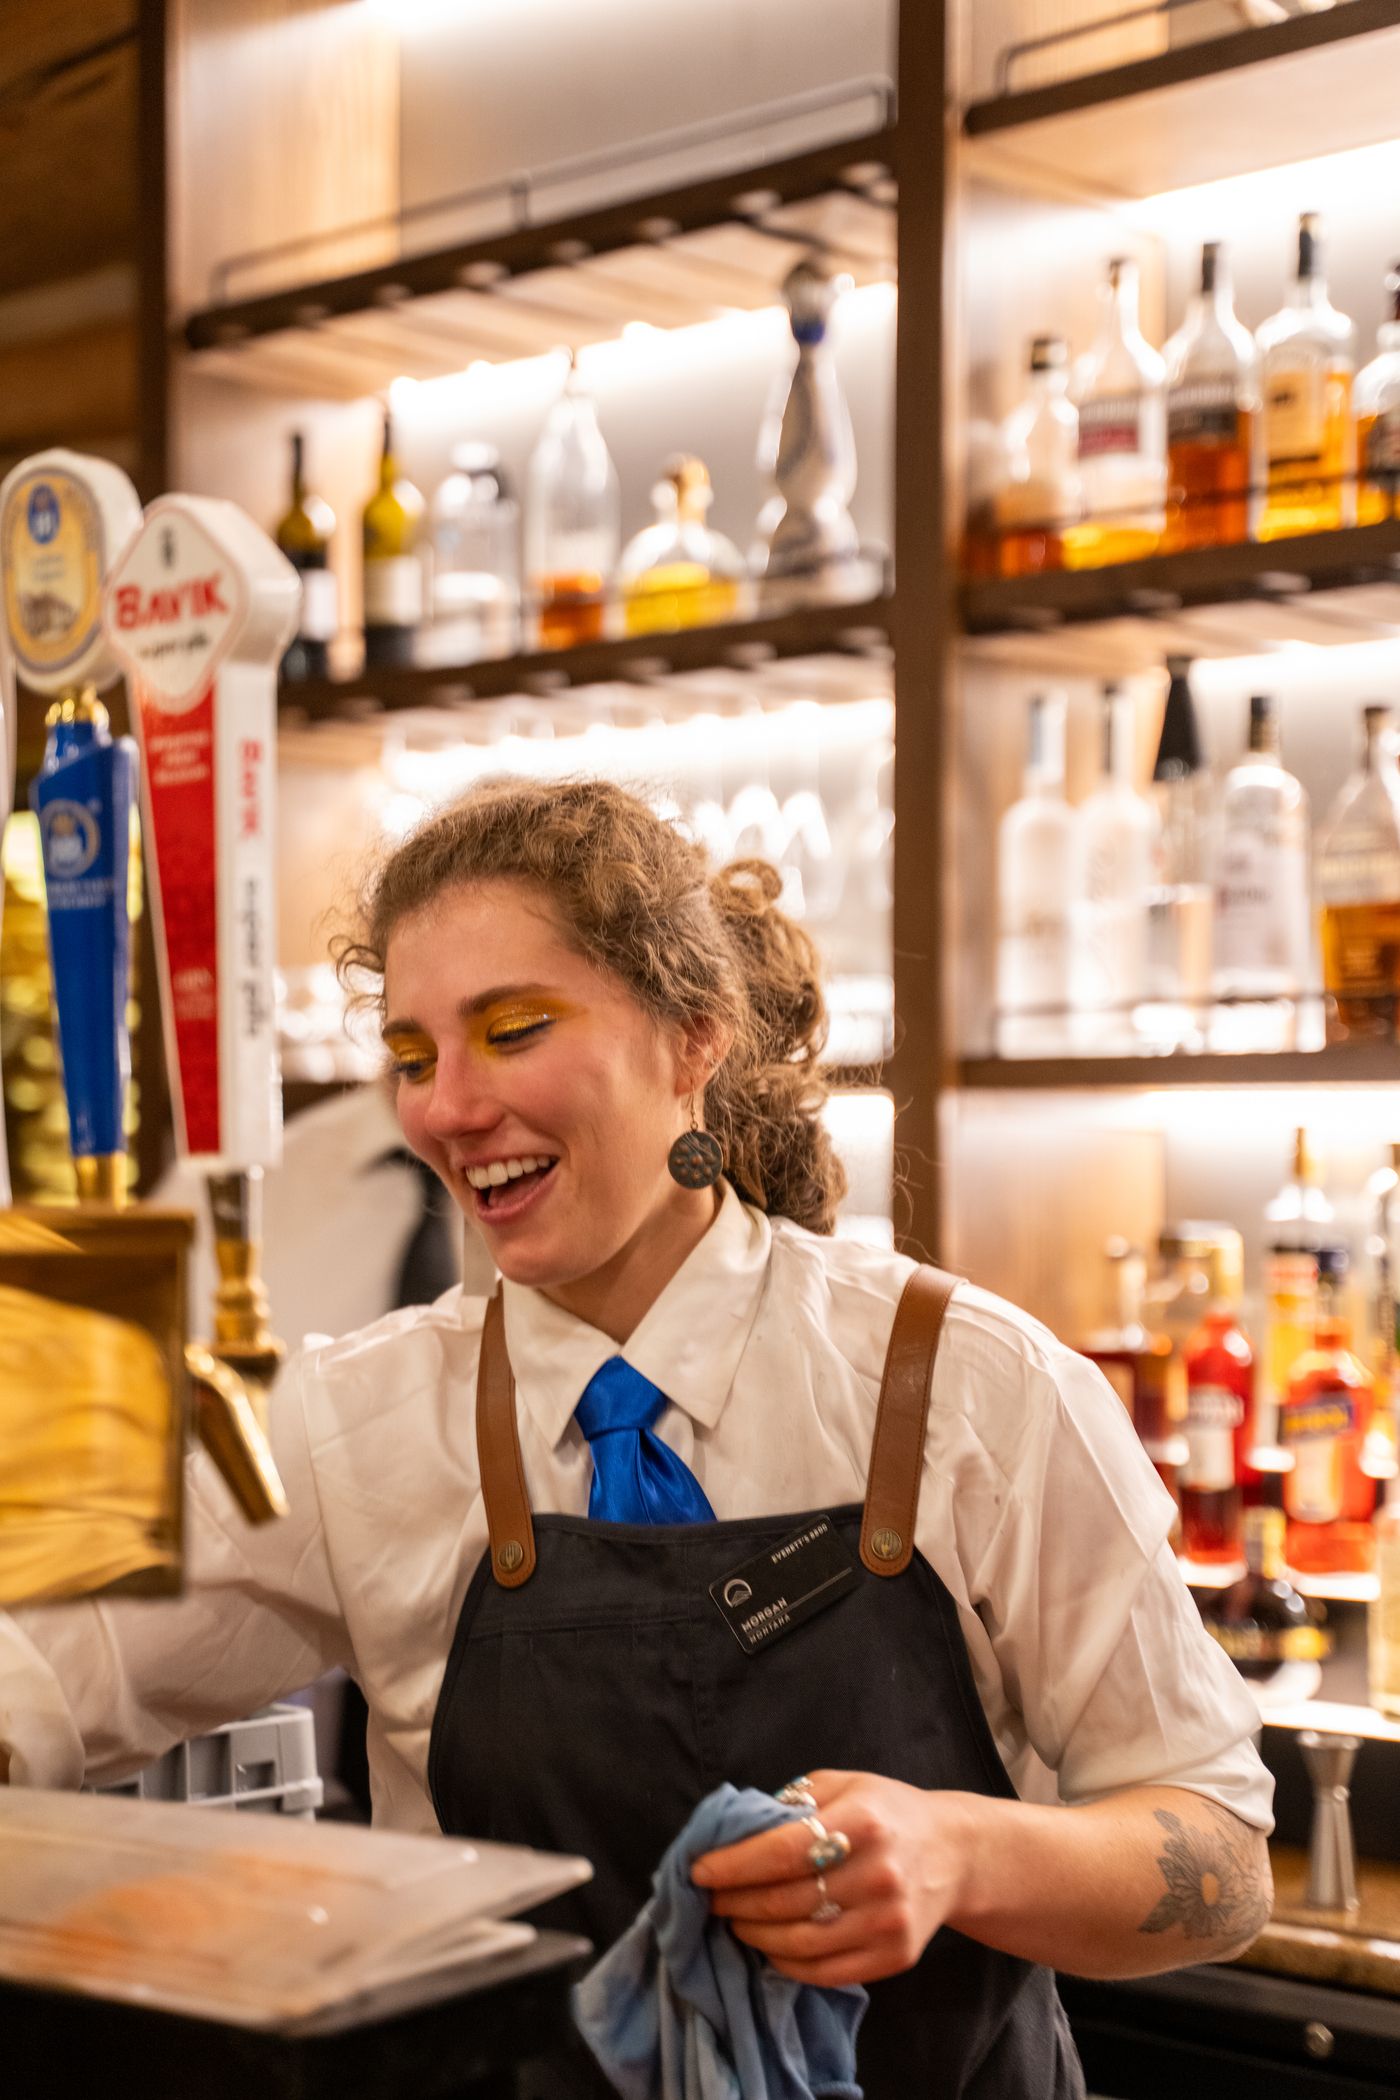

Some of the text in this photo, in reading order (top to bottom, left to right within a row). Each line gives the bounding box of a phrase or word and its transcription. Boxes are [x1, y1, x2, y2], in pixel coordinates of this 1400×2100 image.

[771, 1533, 811, 1565] EVERETT'S
[740, 1596, 788, 1634] MORGAN
[749, 1613, 791, 1645] MONTANA
